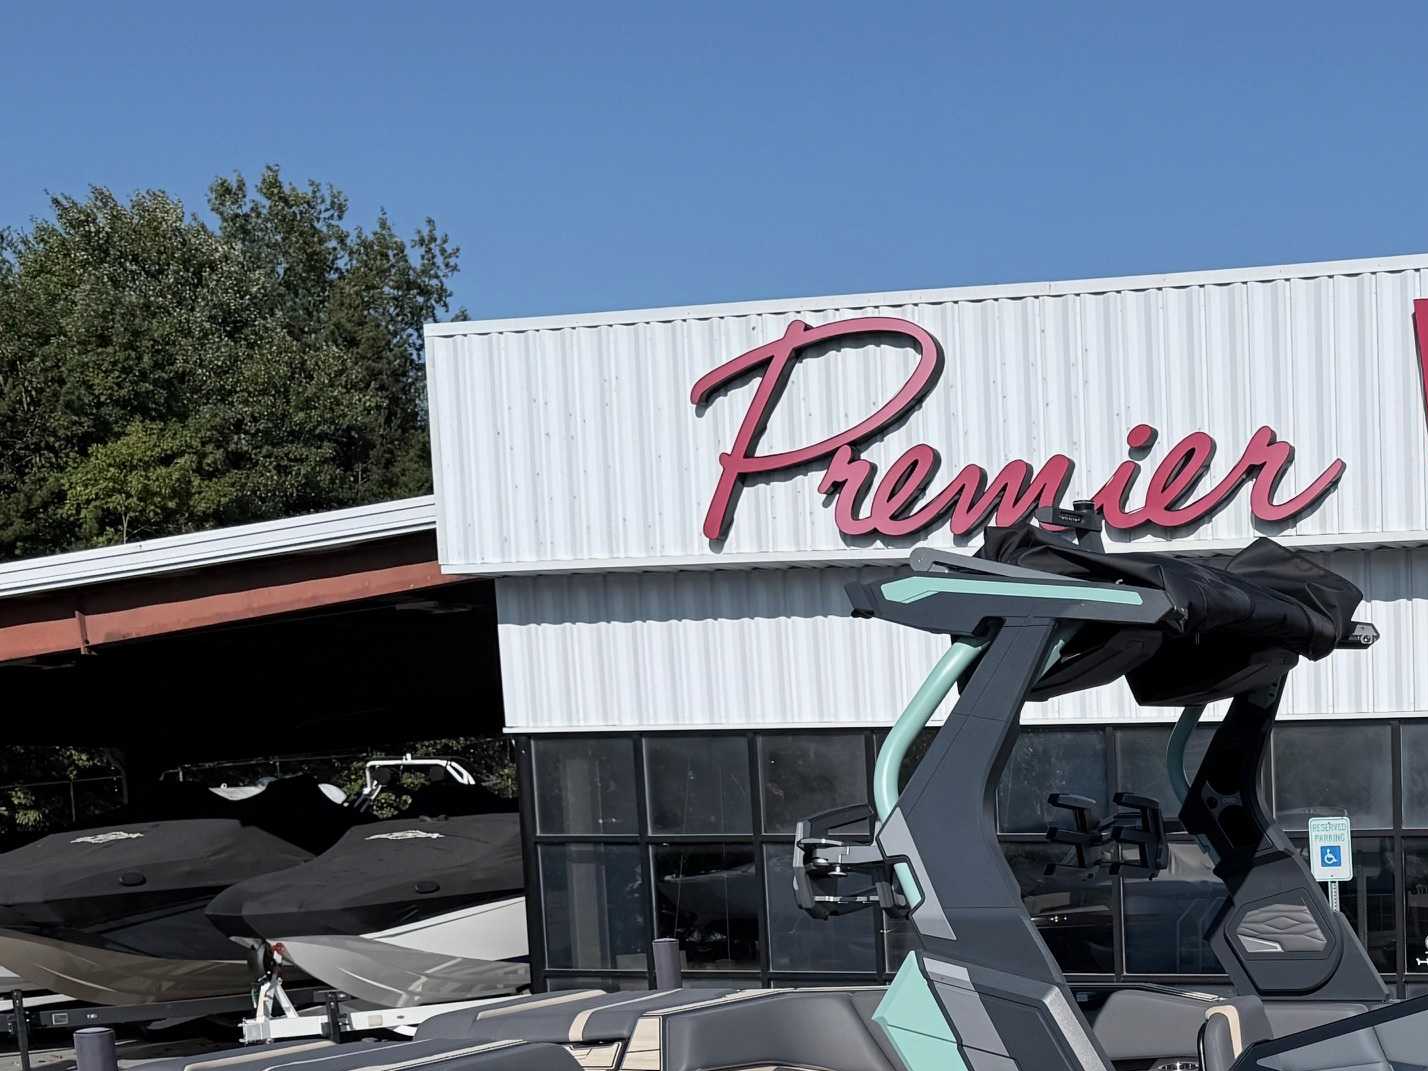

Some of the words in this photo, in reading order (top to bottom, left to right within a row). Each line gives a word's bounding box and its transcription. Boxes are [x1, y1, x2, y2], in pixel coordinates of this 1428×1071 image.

[690, 317, 1345, 540] Premier
[1312, 823, 1347, 832] RESERVED
[1313, 833, 1345, 842] PARKING
